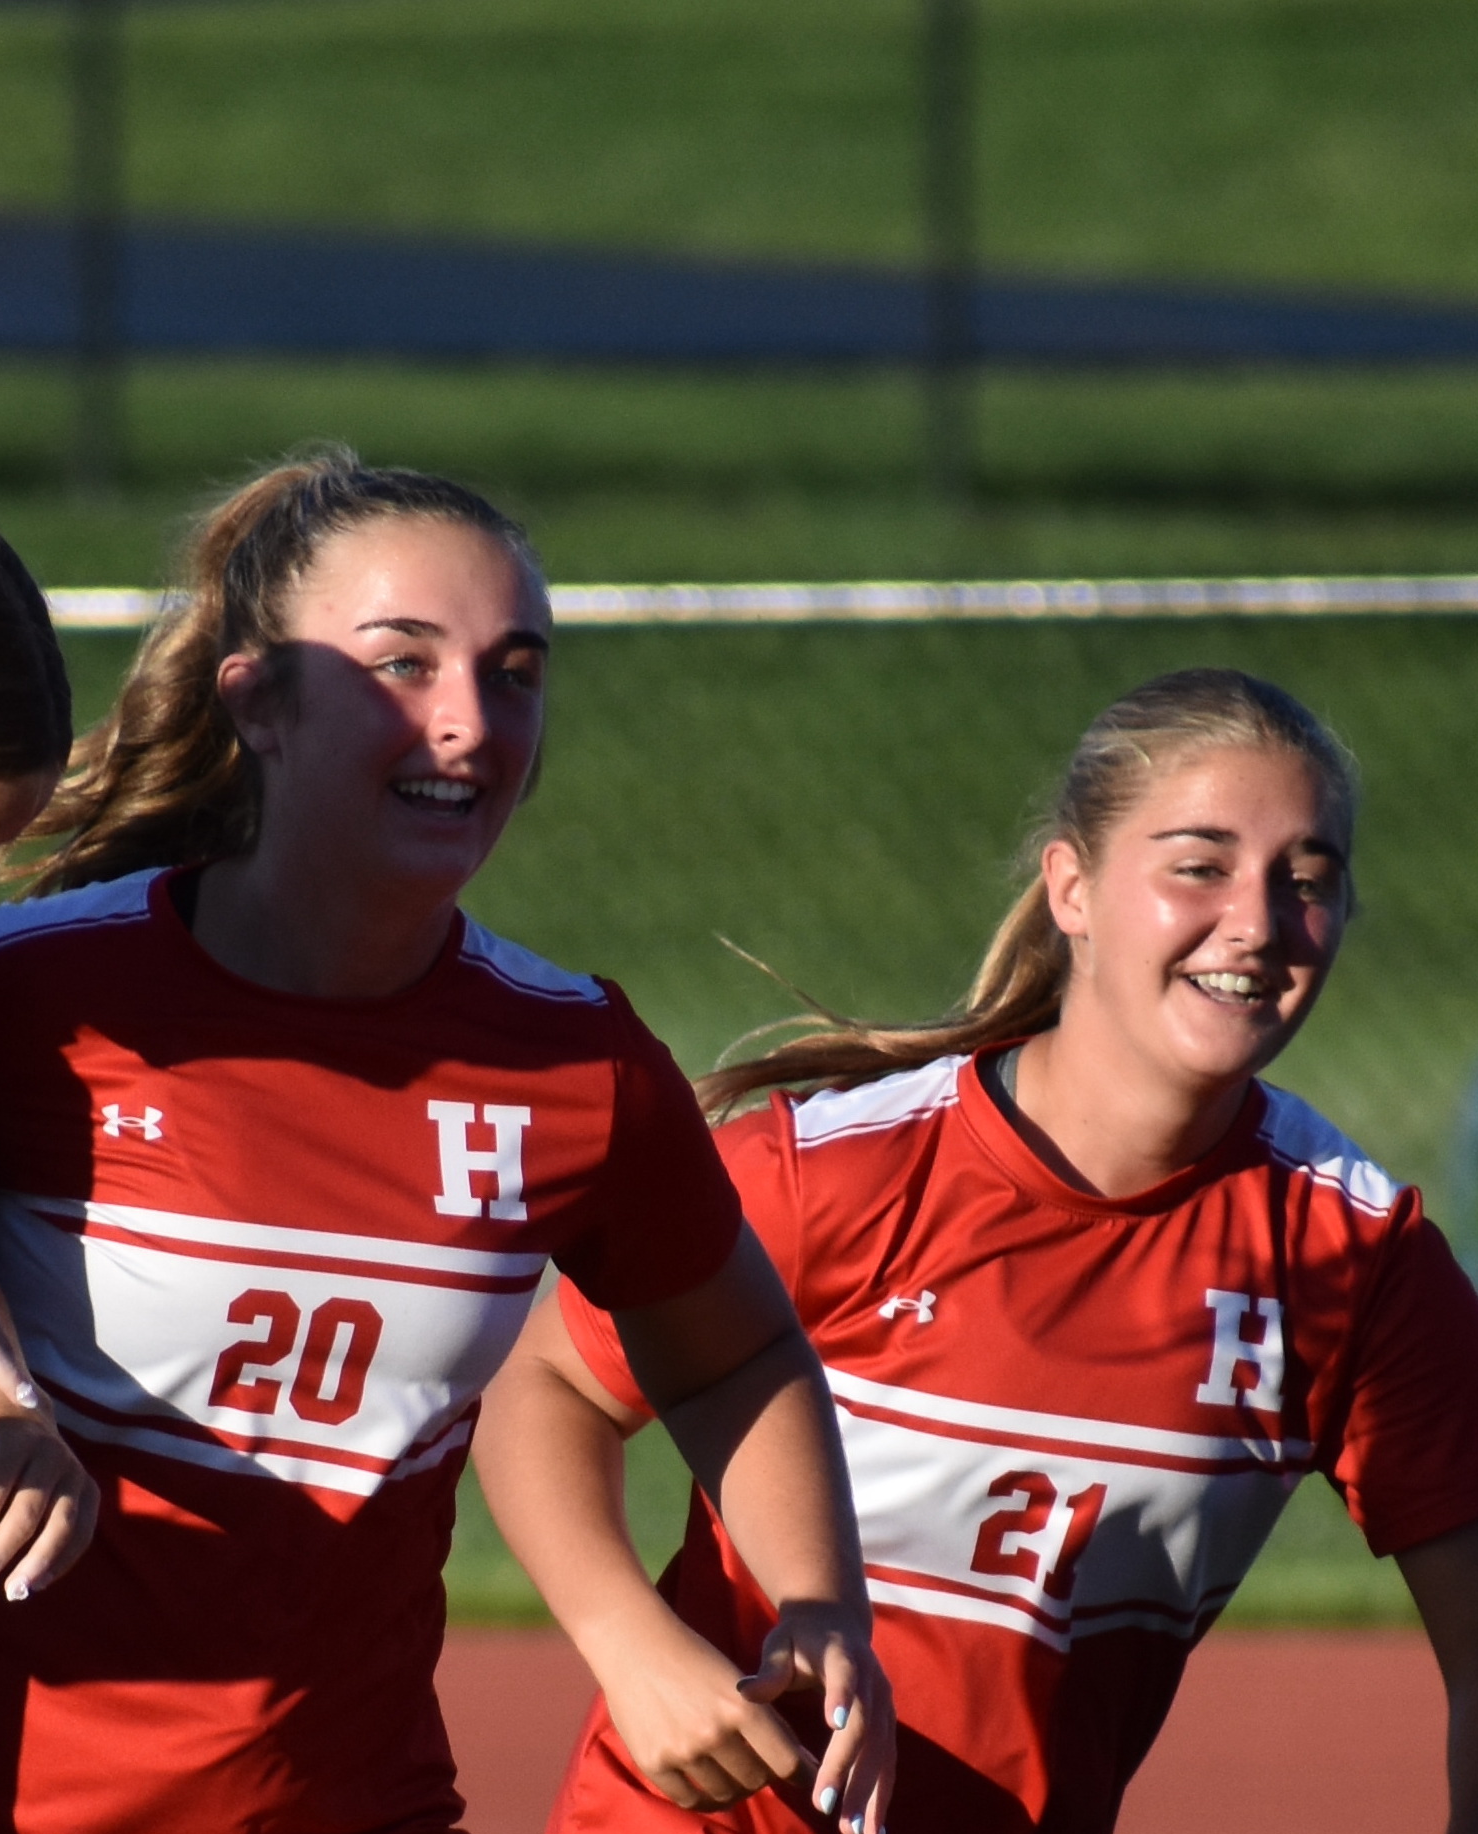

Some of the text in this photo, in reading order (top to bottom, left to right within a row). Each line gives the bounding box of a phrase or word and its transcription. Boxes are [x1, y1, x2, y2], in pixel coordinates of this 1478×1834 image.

[427, 1099, 532, 1221] H
[208, 1288, 384, 1426] 20
[1196, 1288, 1285, 1412] H
[970, 1470, 1108, 1602] 21
